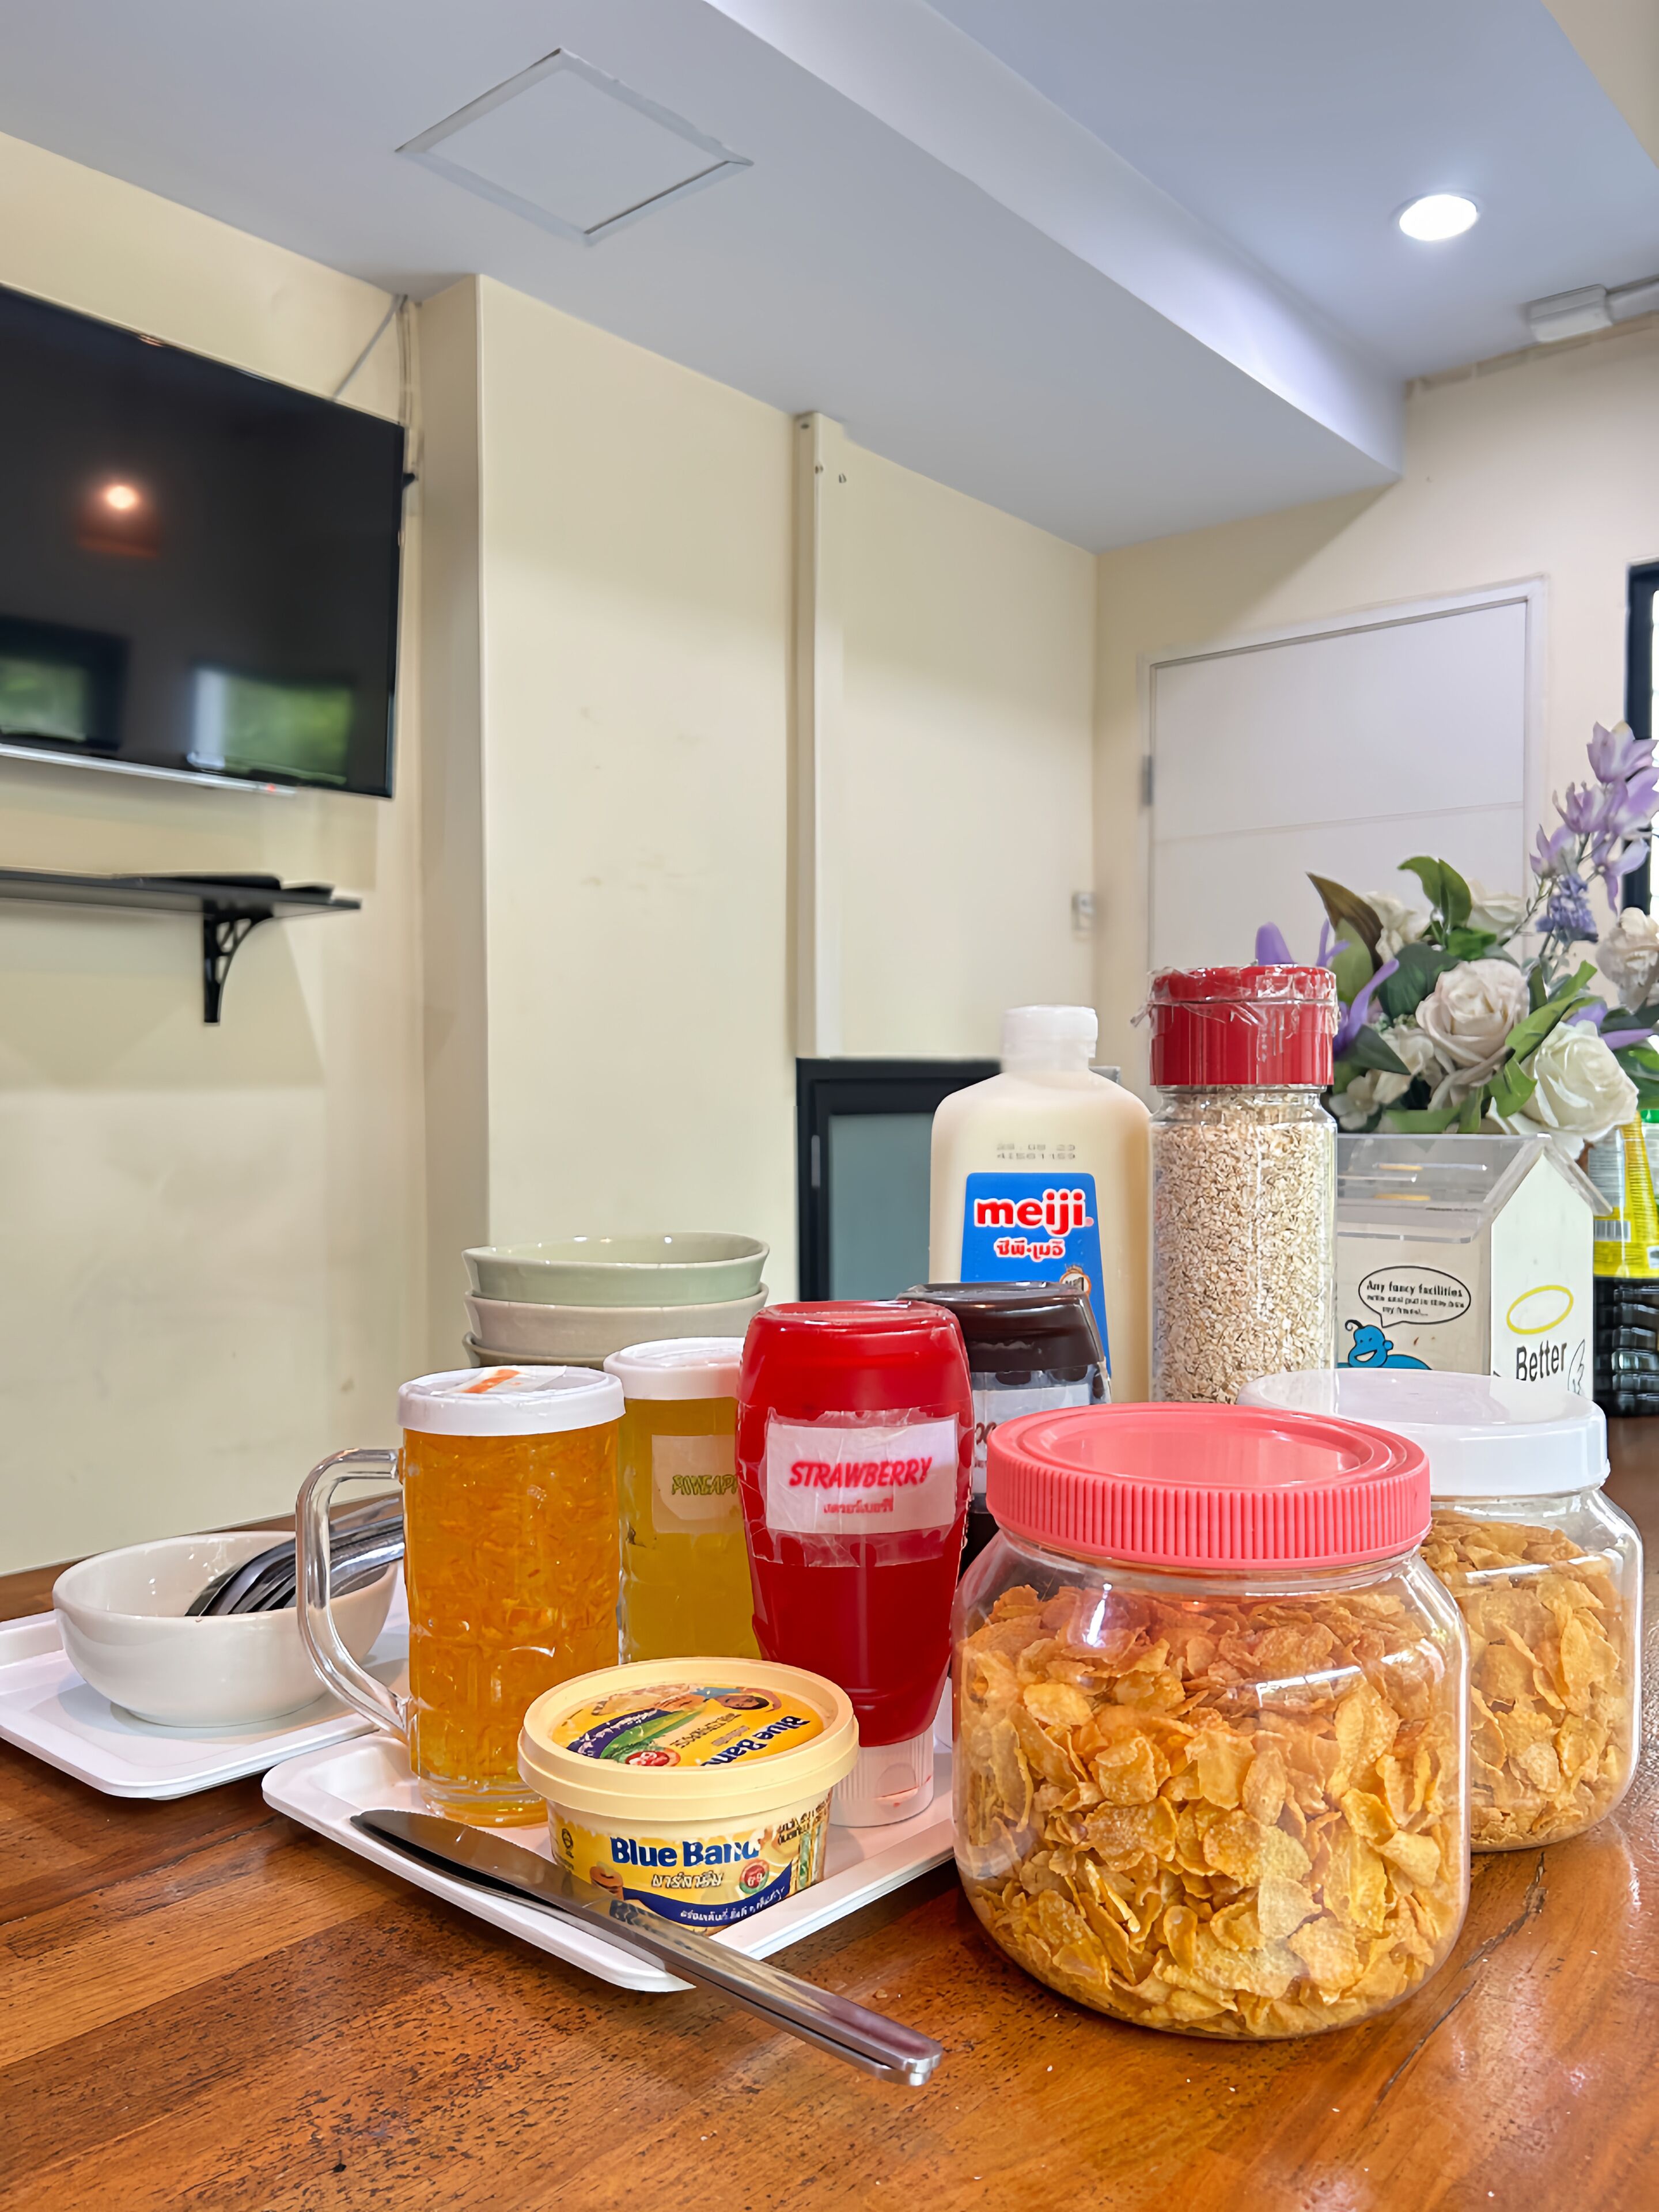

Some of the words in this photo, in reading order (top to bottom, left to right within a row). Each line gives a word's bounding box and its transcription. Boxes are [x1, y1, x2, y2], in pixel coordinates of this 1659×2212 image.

[976, 1191, 1084, 1236] meiji
[1367, 1280, 1385, 1293] Any
[1389, 1281, 1415, 1296] fancy
[1516, 1340, 1567, 1382] Better
[789, 1457, 933, 1490] STRAWBERRY
[752, 1716, 810, 1740] Blue
[609, 1836, 677, 1867] Blue
